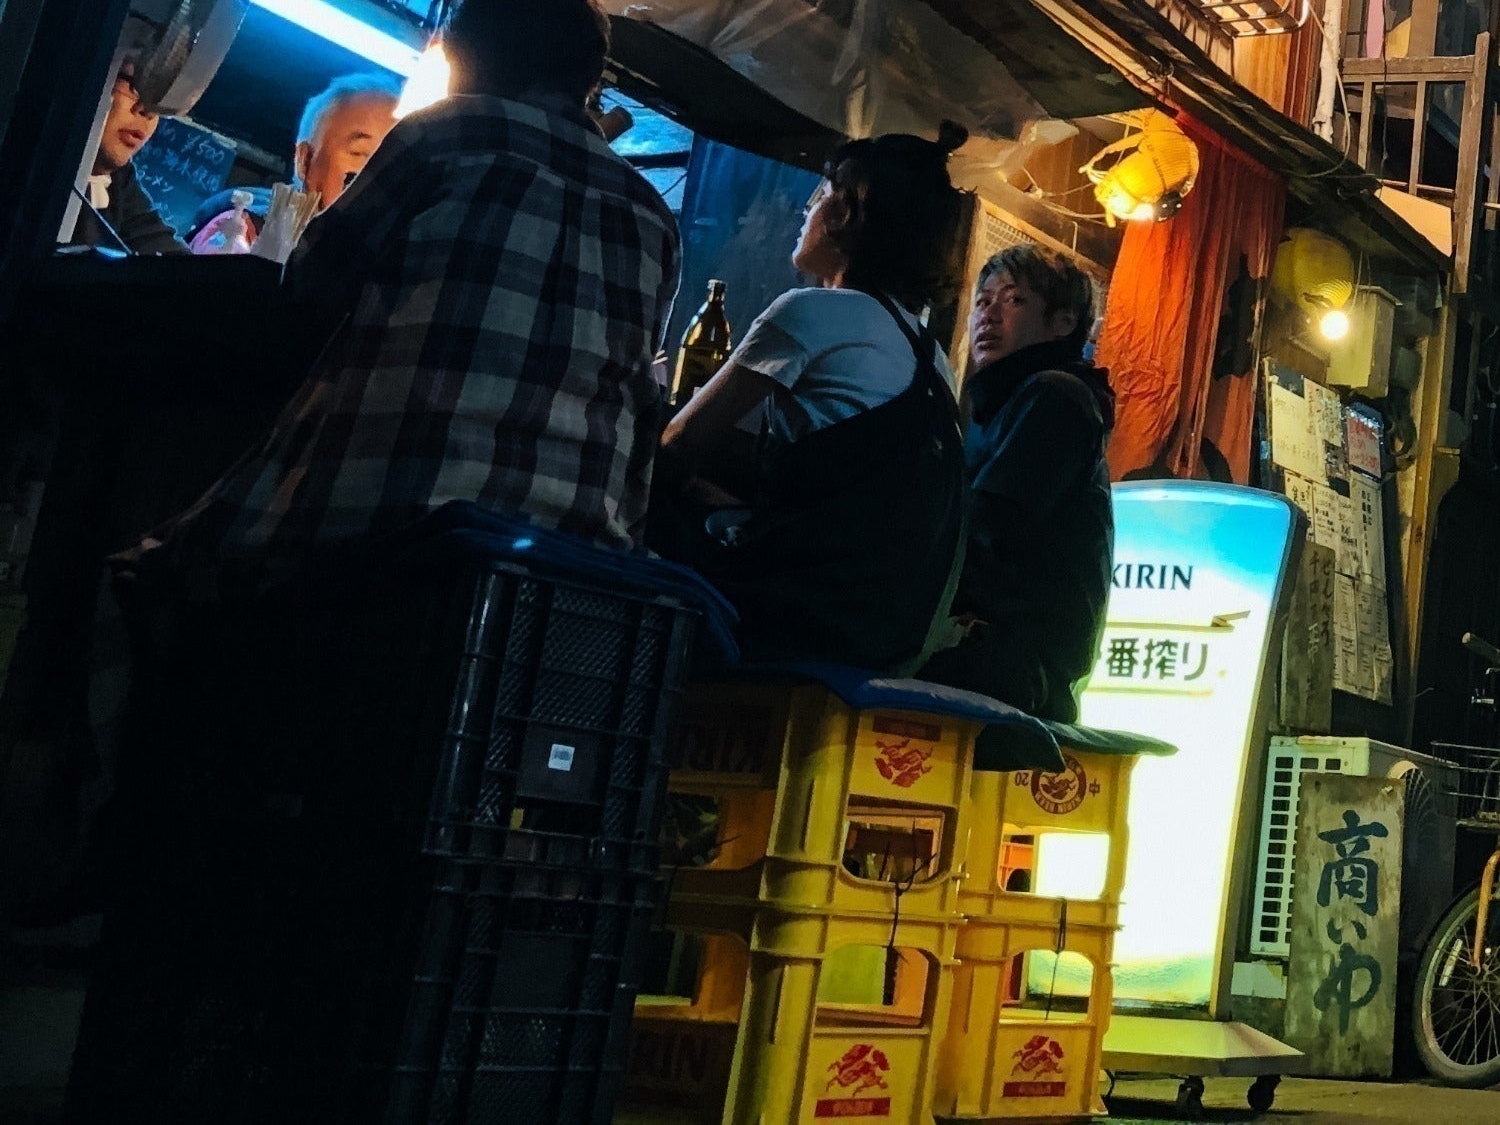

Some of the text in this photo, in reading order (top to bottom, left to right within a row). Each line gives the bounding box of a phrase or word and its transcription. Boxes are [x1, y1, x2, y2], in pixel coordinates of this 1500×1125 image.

[1100, 638, 1208, 681] 番搾り
[1014, 772, 1029, 787] 20
[1089, 778, 1100, 798] 中
